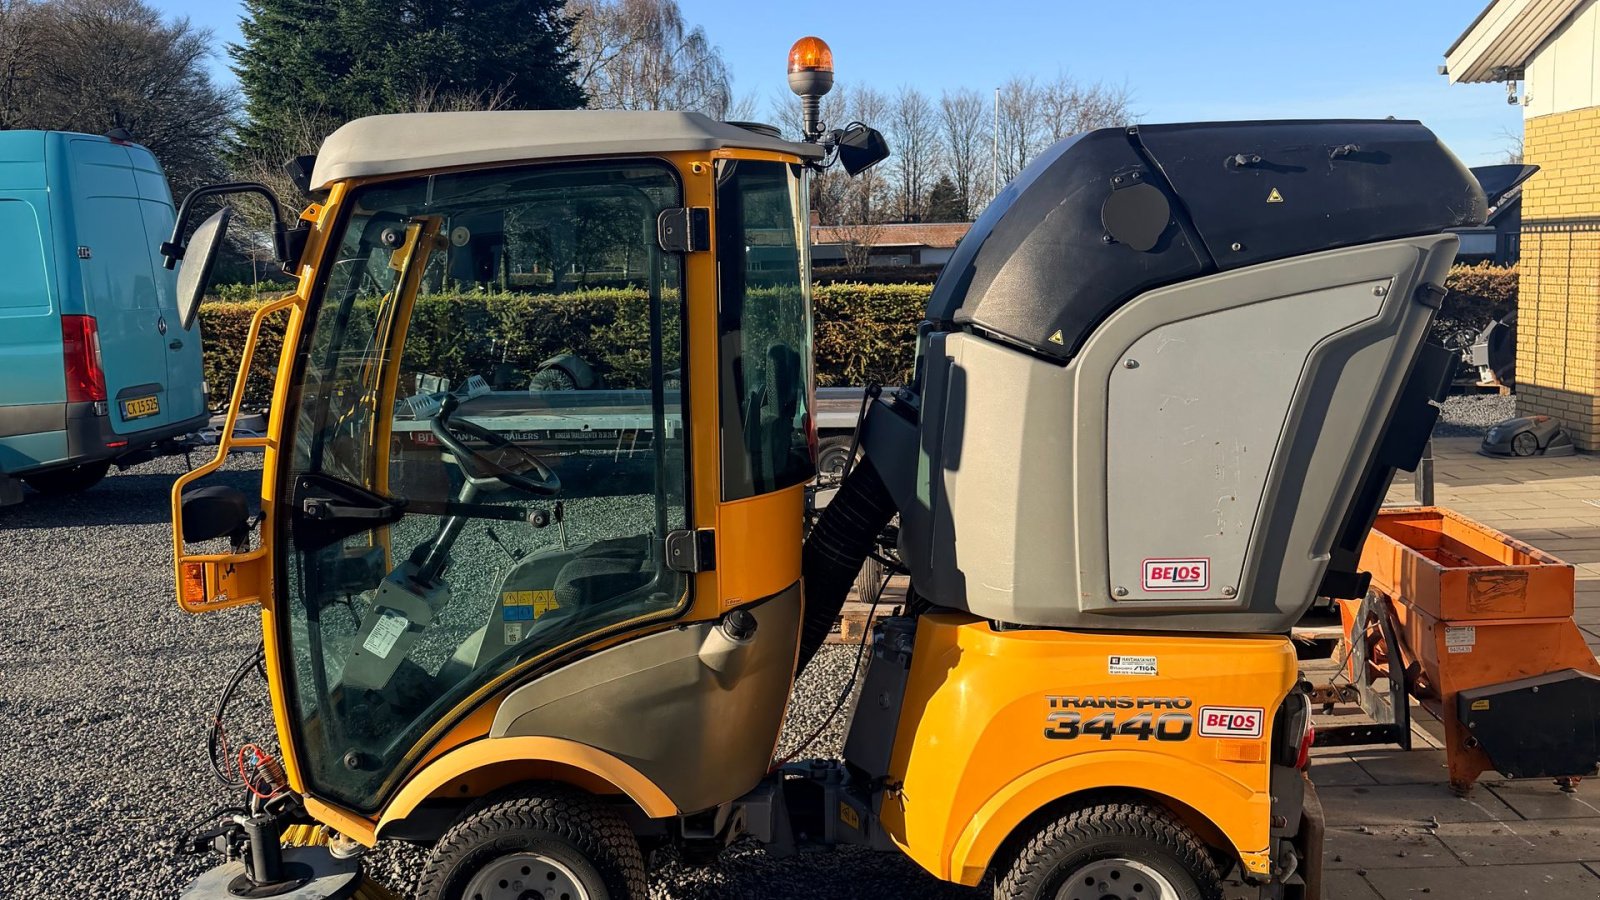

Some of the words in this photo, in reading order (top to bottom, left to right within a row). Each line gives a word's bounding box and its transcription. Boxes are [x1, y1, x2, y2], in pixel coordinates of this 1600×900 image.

[127, 402, 137, 415] CX
[138, 400, 146, 413] 15
[1151, 566, 1201, 583] BELOS
[1045, 694, 1135, 709] TRANS
[1137, 695, 1193, 710] PRO
[1044, 711, 1193, 741] 3440
[1207, 714, 1256, 731] BELOS
